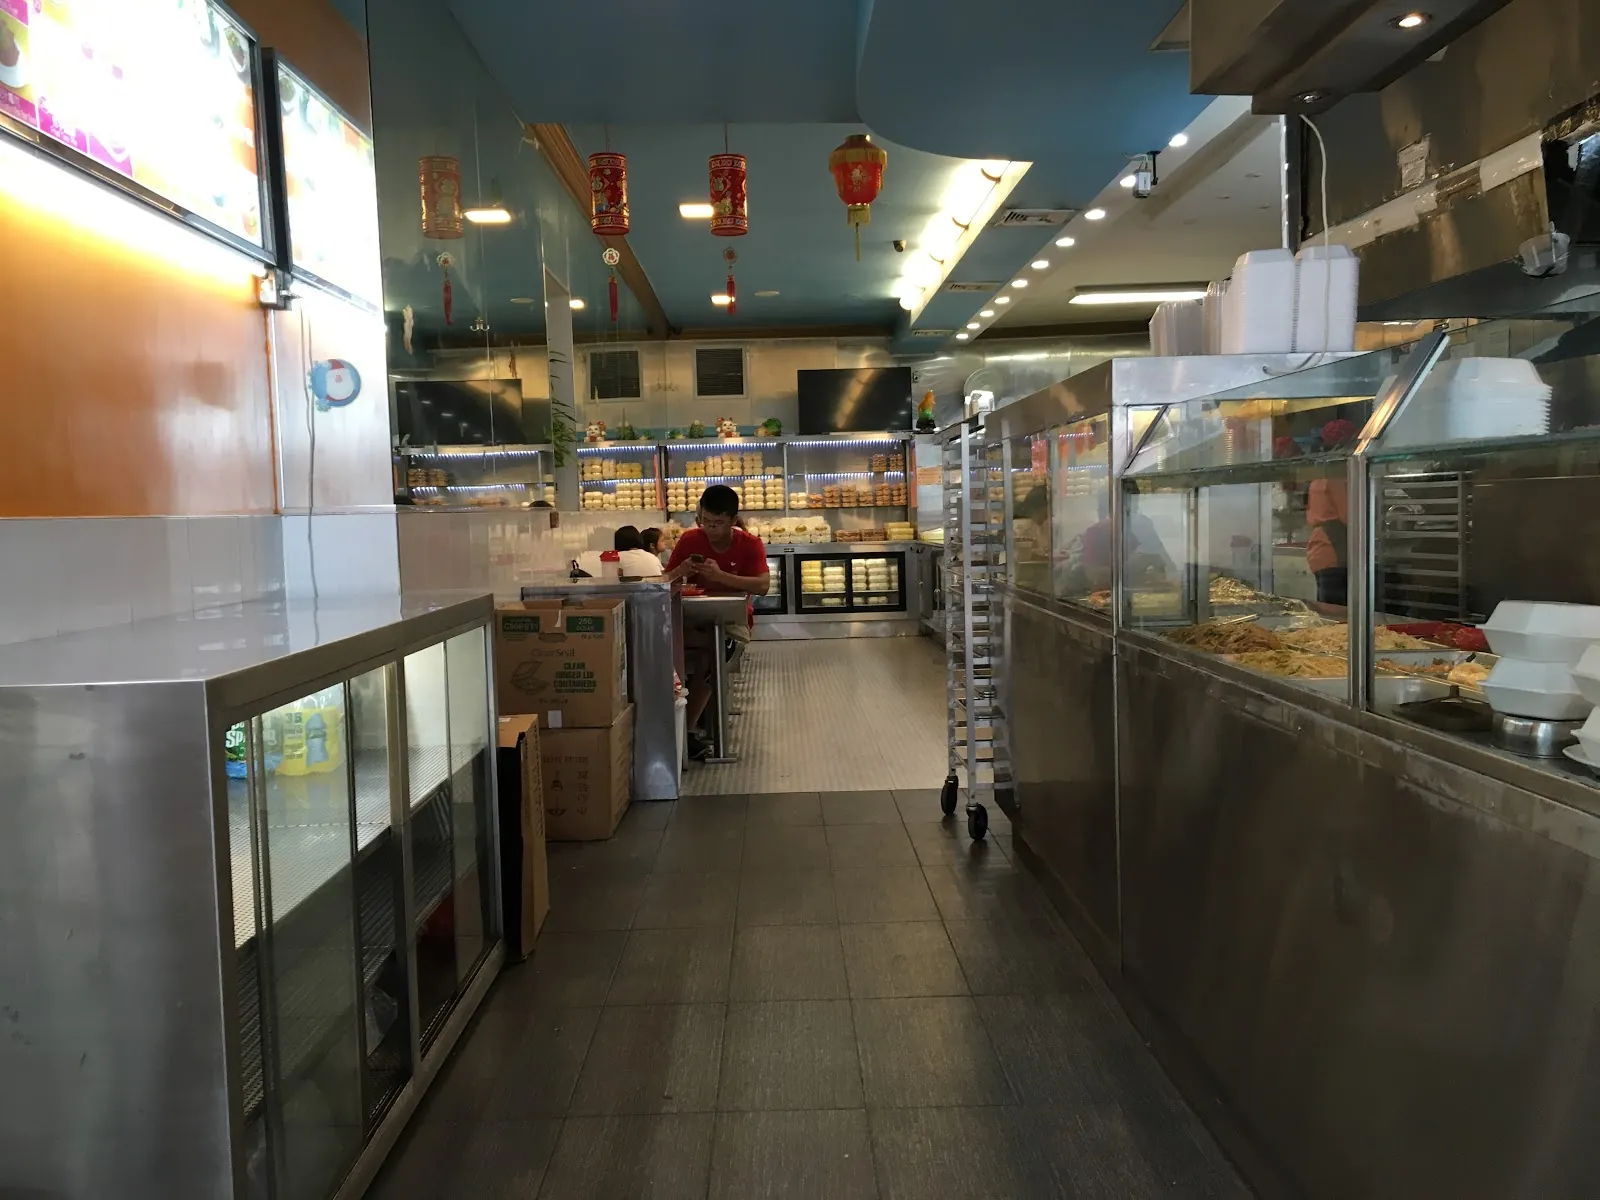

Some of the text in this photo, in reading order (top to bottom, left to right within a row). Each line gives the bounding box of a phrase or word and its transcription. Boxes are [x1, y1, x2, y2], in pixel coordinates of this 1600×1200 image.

[578, 617, 593, 625] 250
[563, 662, 586, 670] CLEAR
[583, 671, 594, 679] LID
[553, 680, 597, 688] CONTAINERS
